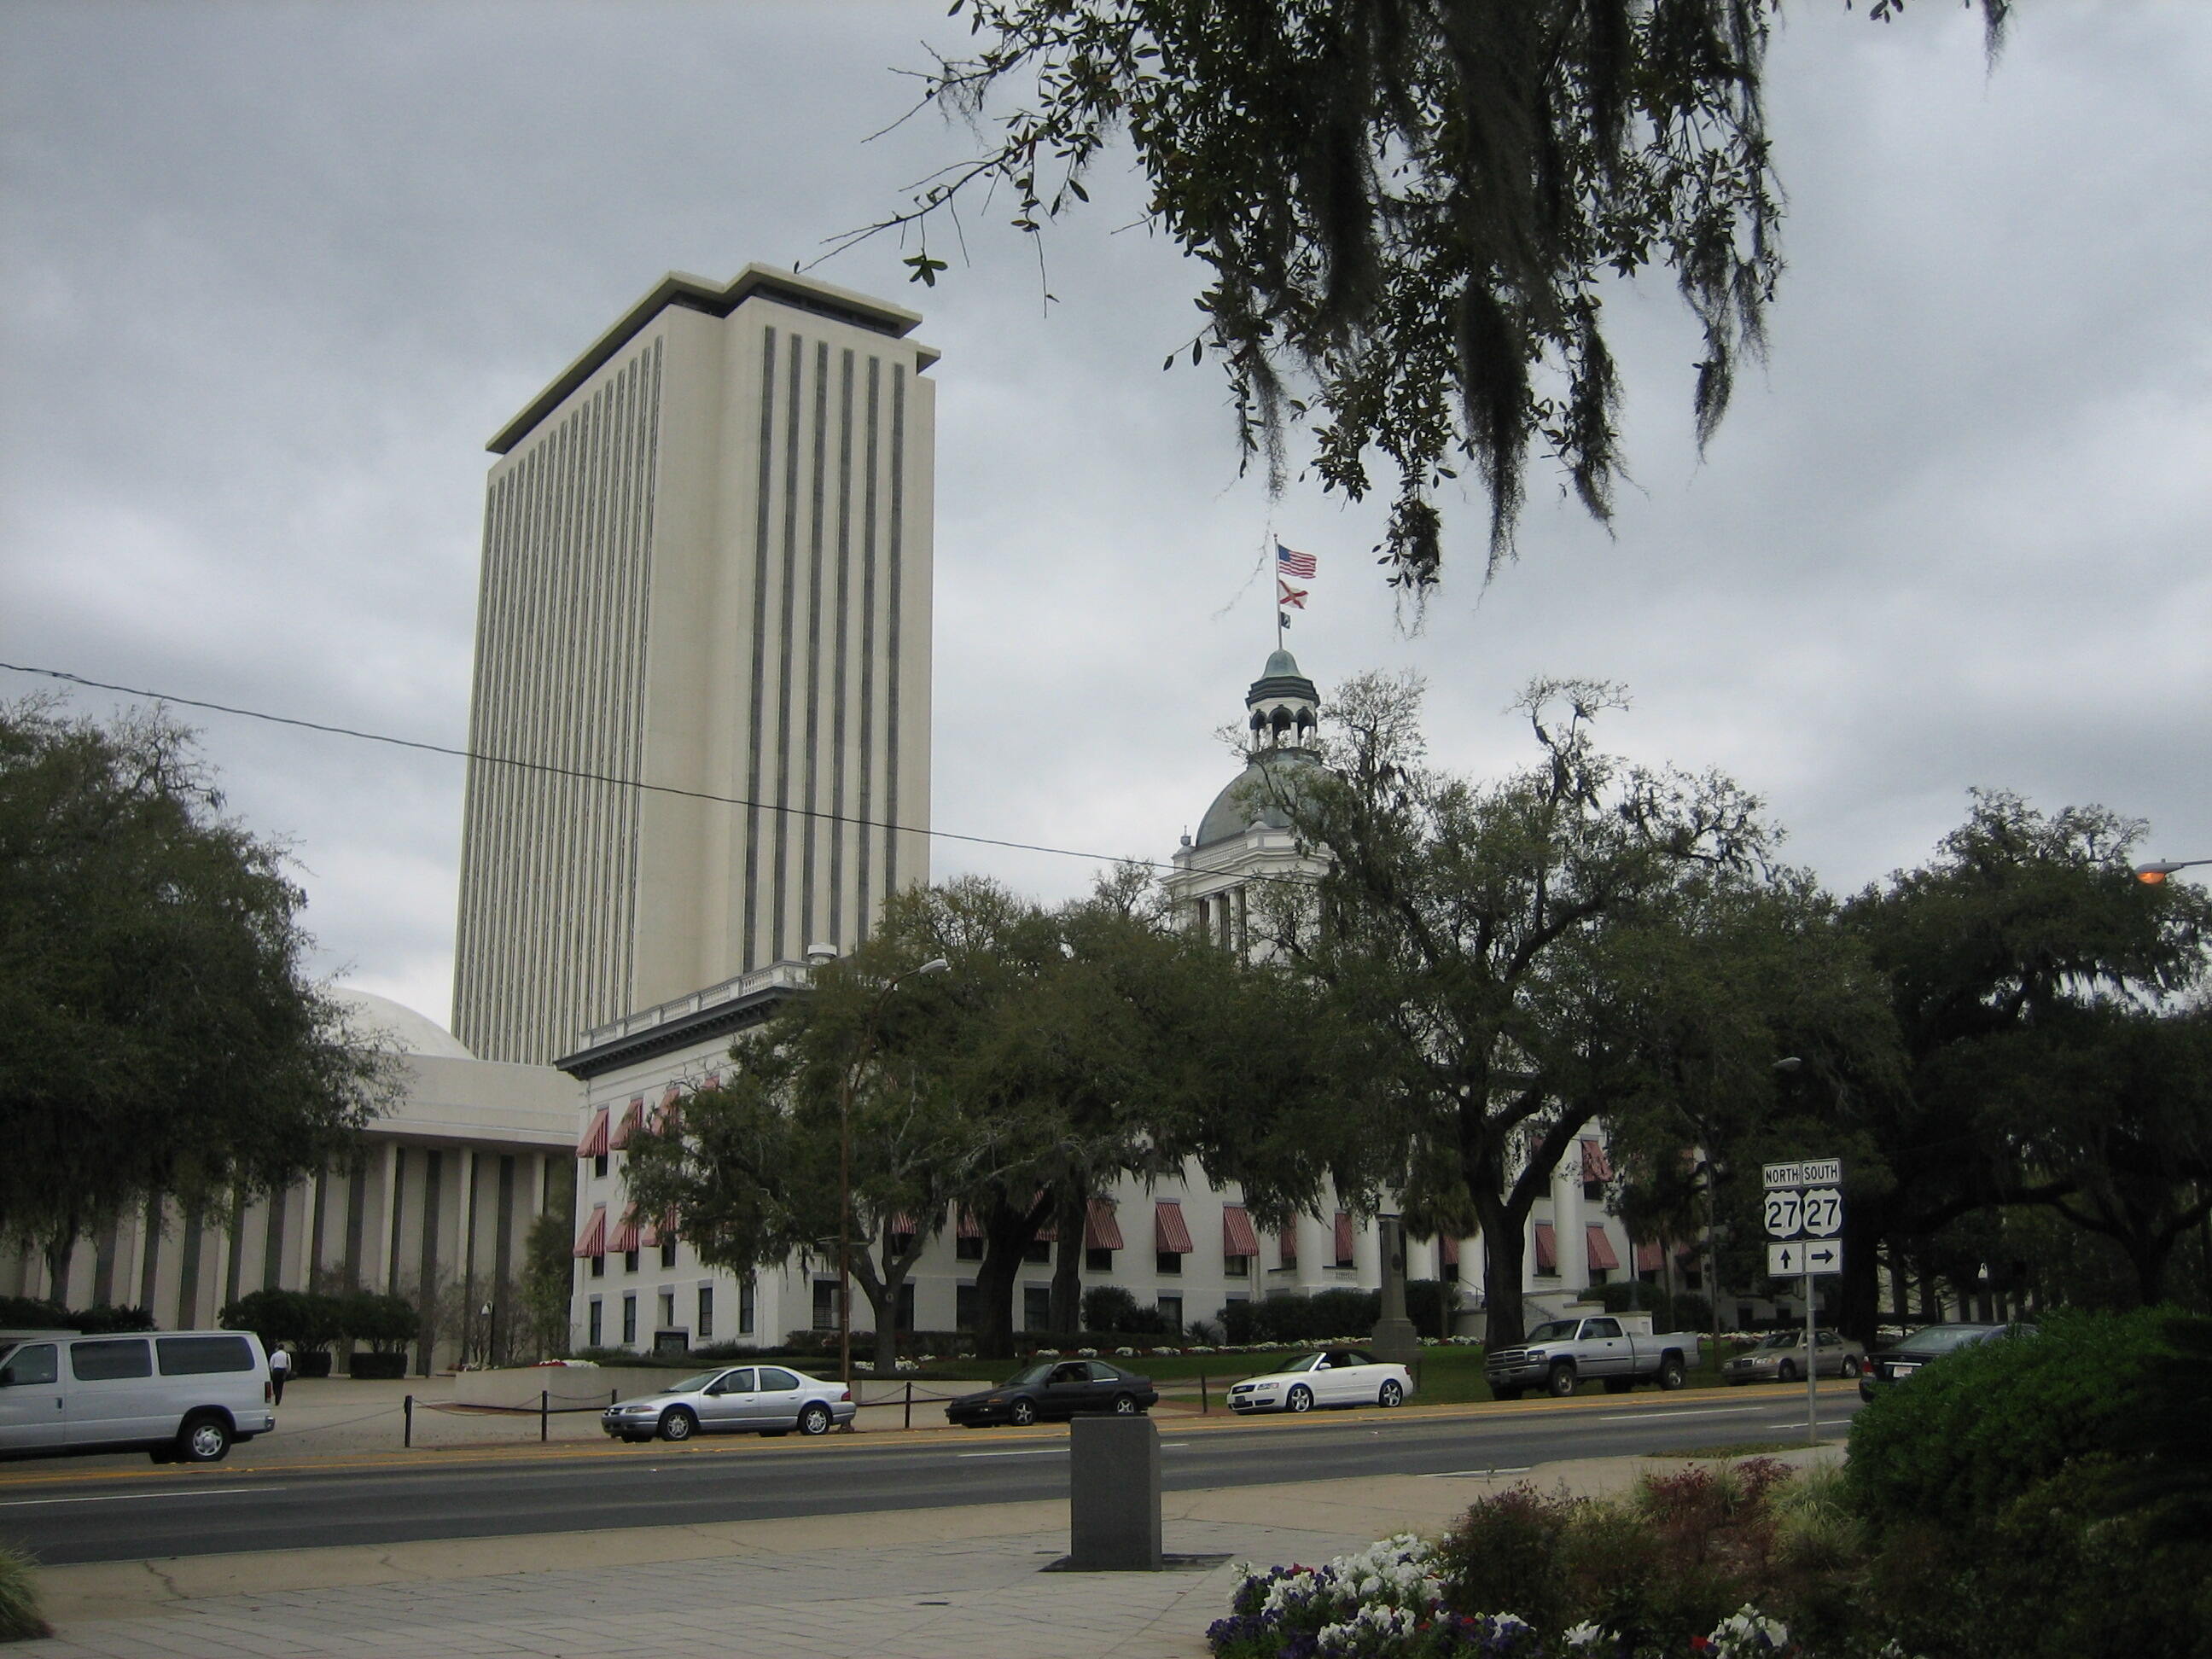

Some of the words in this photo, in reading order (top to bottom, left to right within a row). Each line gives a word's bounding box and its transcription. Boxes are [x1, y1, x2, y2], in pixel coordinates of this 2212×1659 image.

[1766, 1168, 1798, 1183] NORTH
[1804, 1165, 1837, 1180] SOUTH
[1768, 1201, 1797, 1228] 27
[1807, 1199, 1837, 1226] 27
